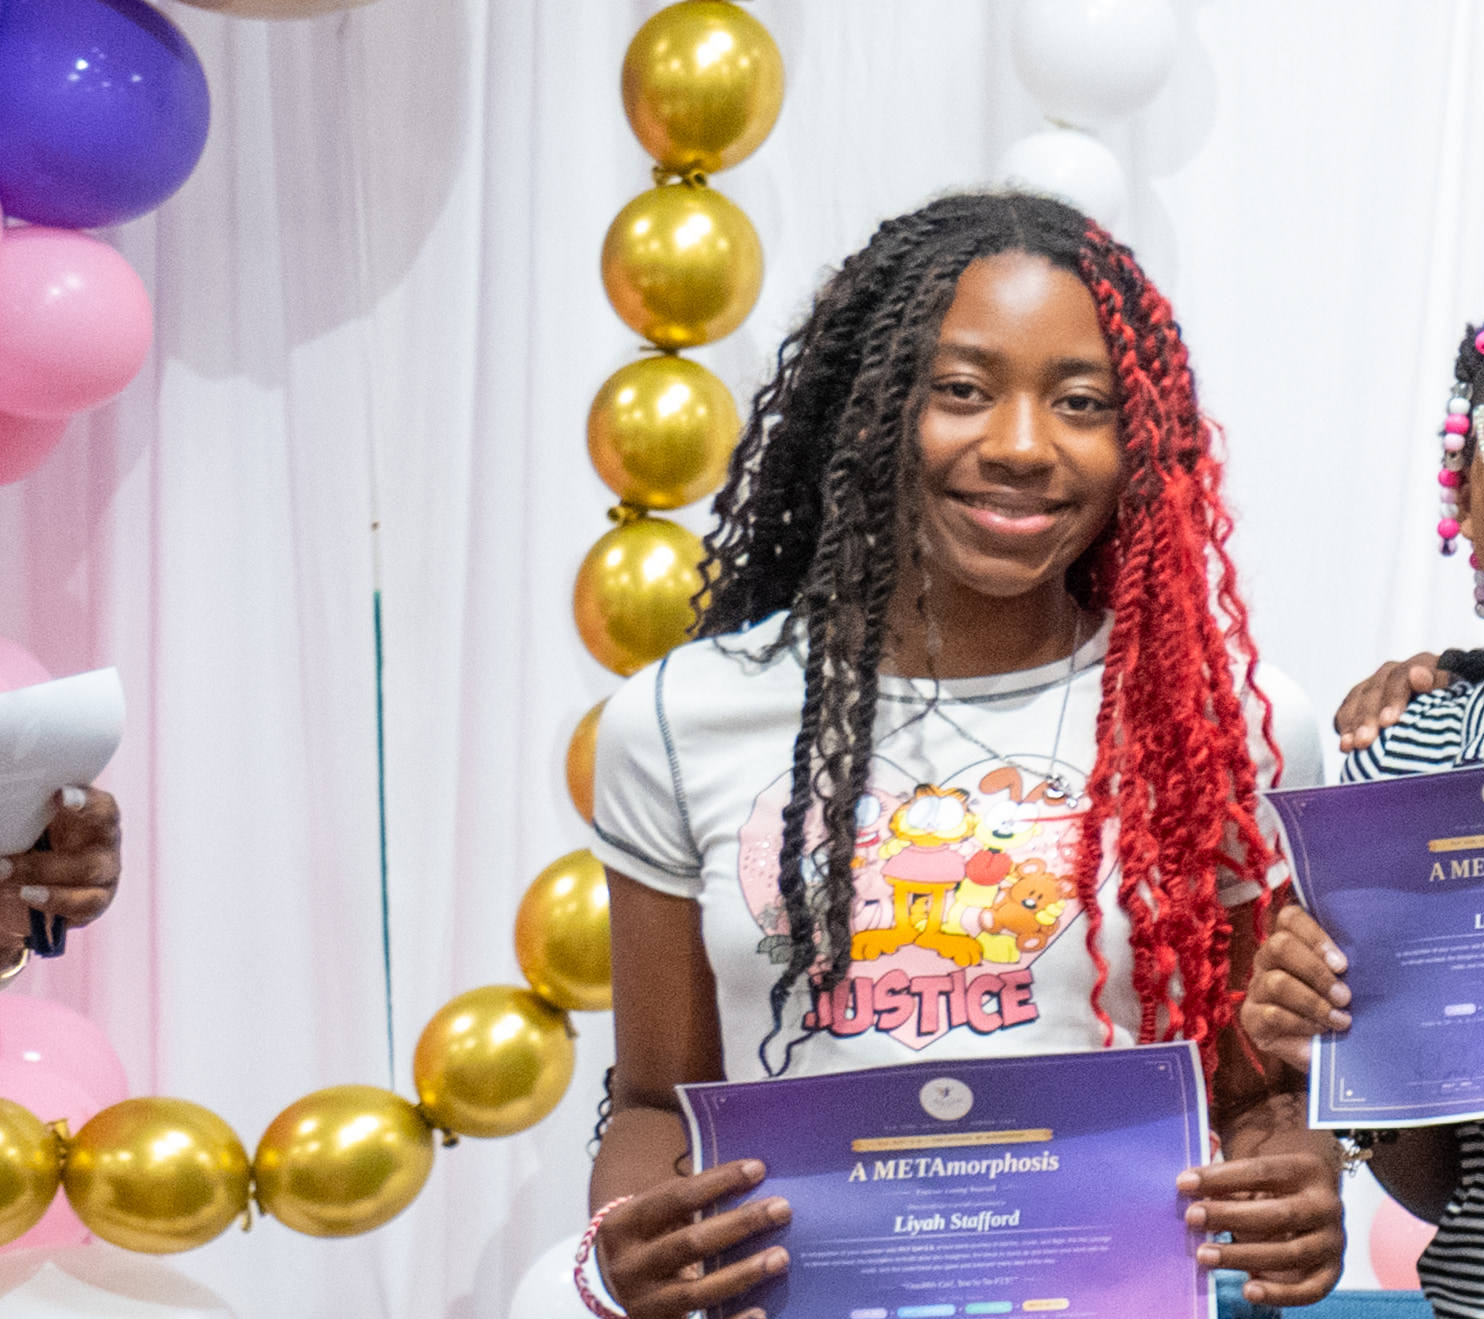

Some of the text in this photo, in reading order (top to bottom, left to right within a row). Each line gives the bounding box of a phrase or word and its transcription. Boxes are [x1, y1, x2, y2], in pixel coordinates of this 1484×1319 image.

[1429, 862, 1446, 882] A
[849, 1151, 1060, 1183] A METAmorphosis
[895, 1210, 1020, 1234] Liyah Stafford
